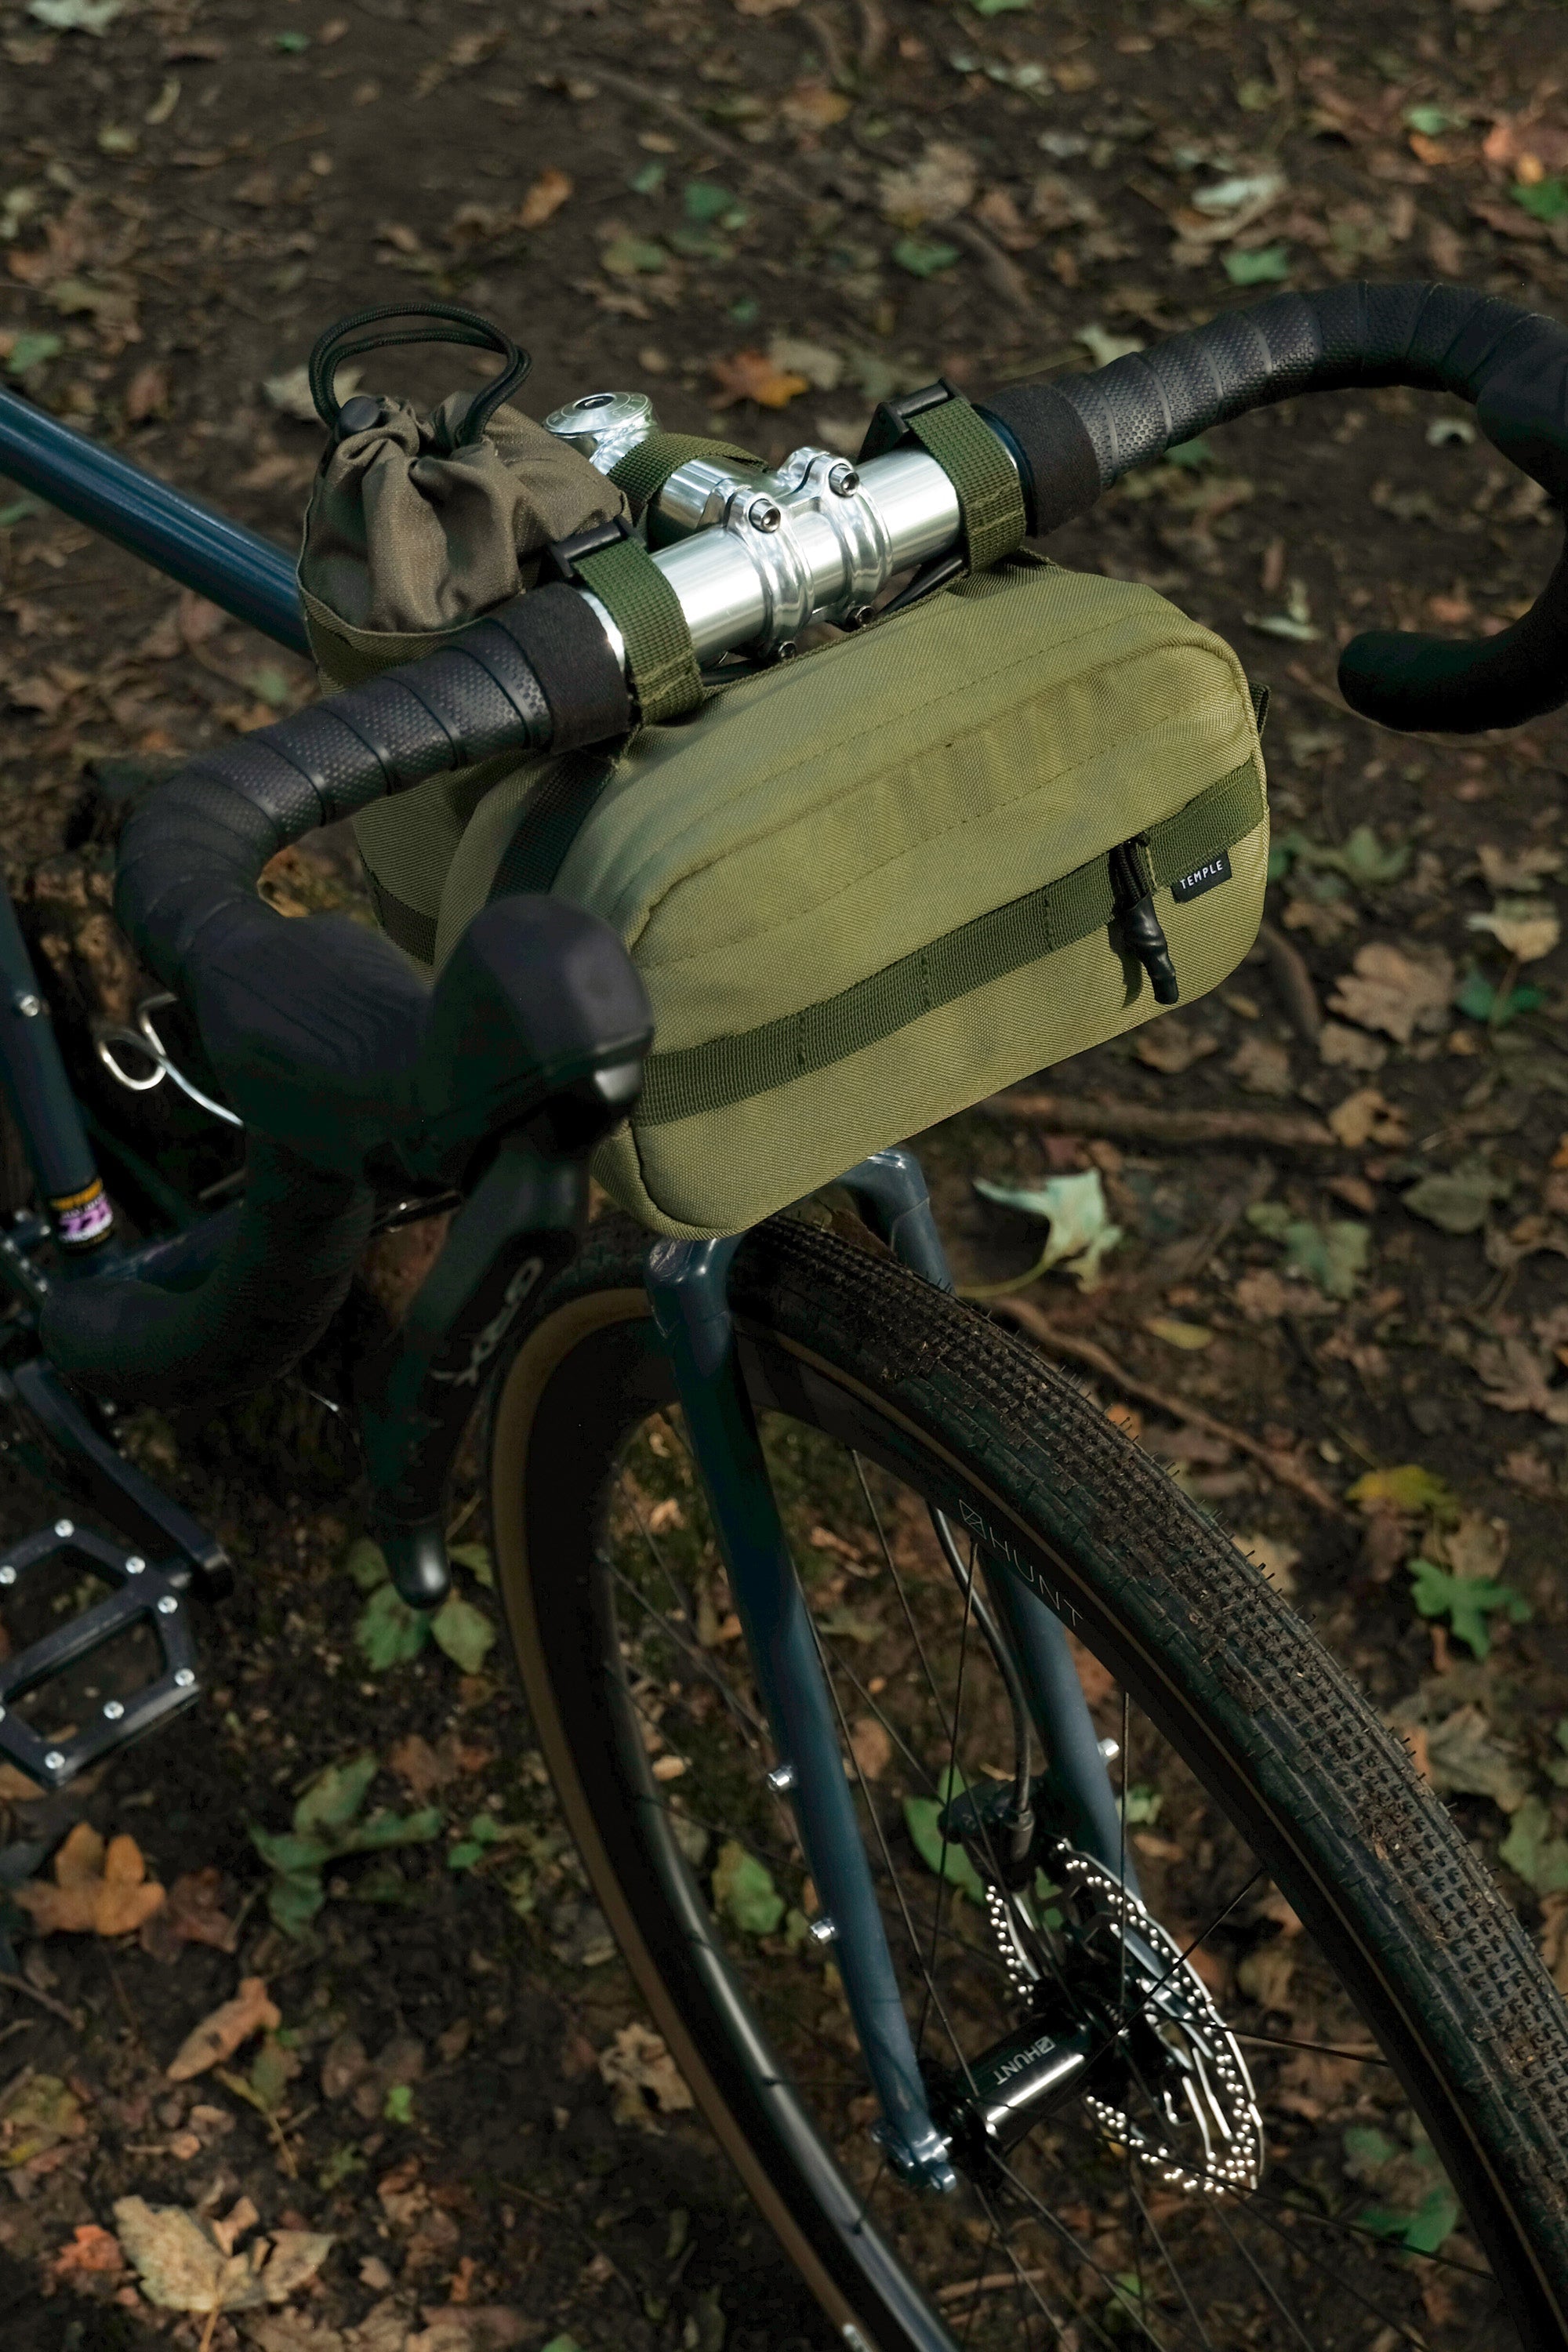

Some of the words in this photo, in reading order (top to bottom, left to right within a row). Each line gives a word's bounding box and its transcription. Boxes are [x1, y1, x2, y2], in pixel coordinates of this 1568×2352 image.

[1180, 859, 1223, 889] TEMPLE
[989, 1526, 1085, 1627] HUNT
[993, 2045, 1042, 2085] HUNT
